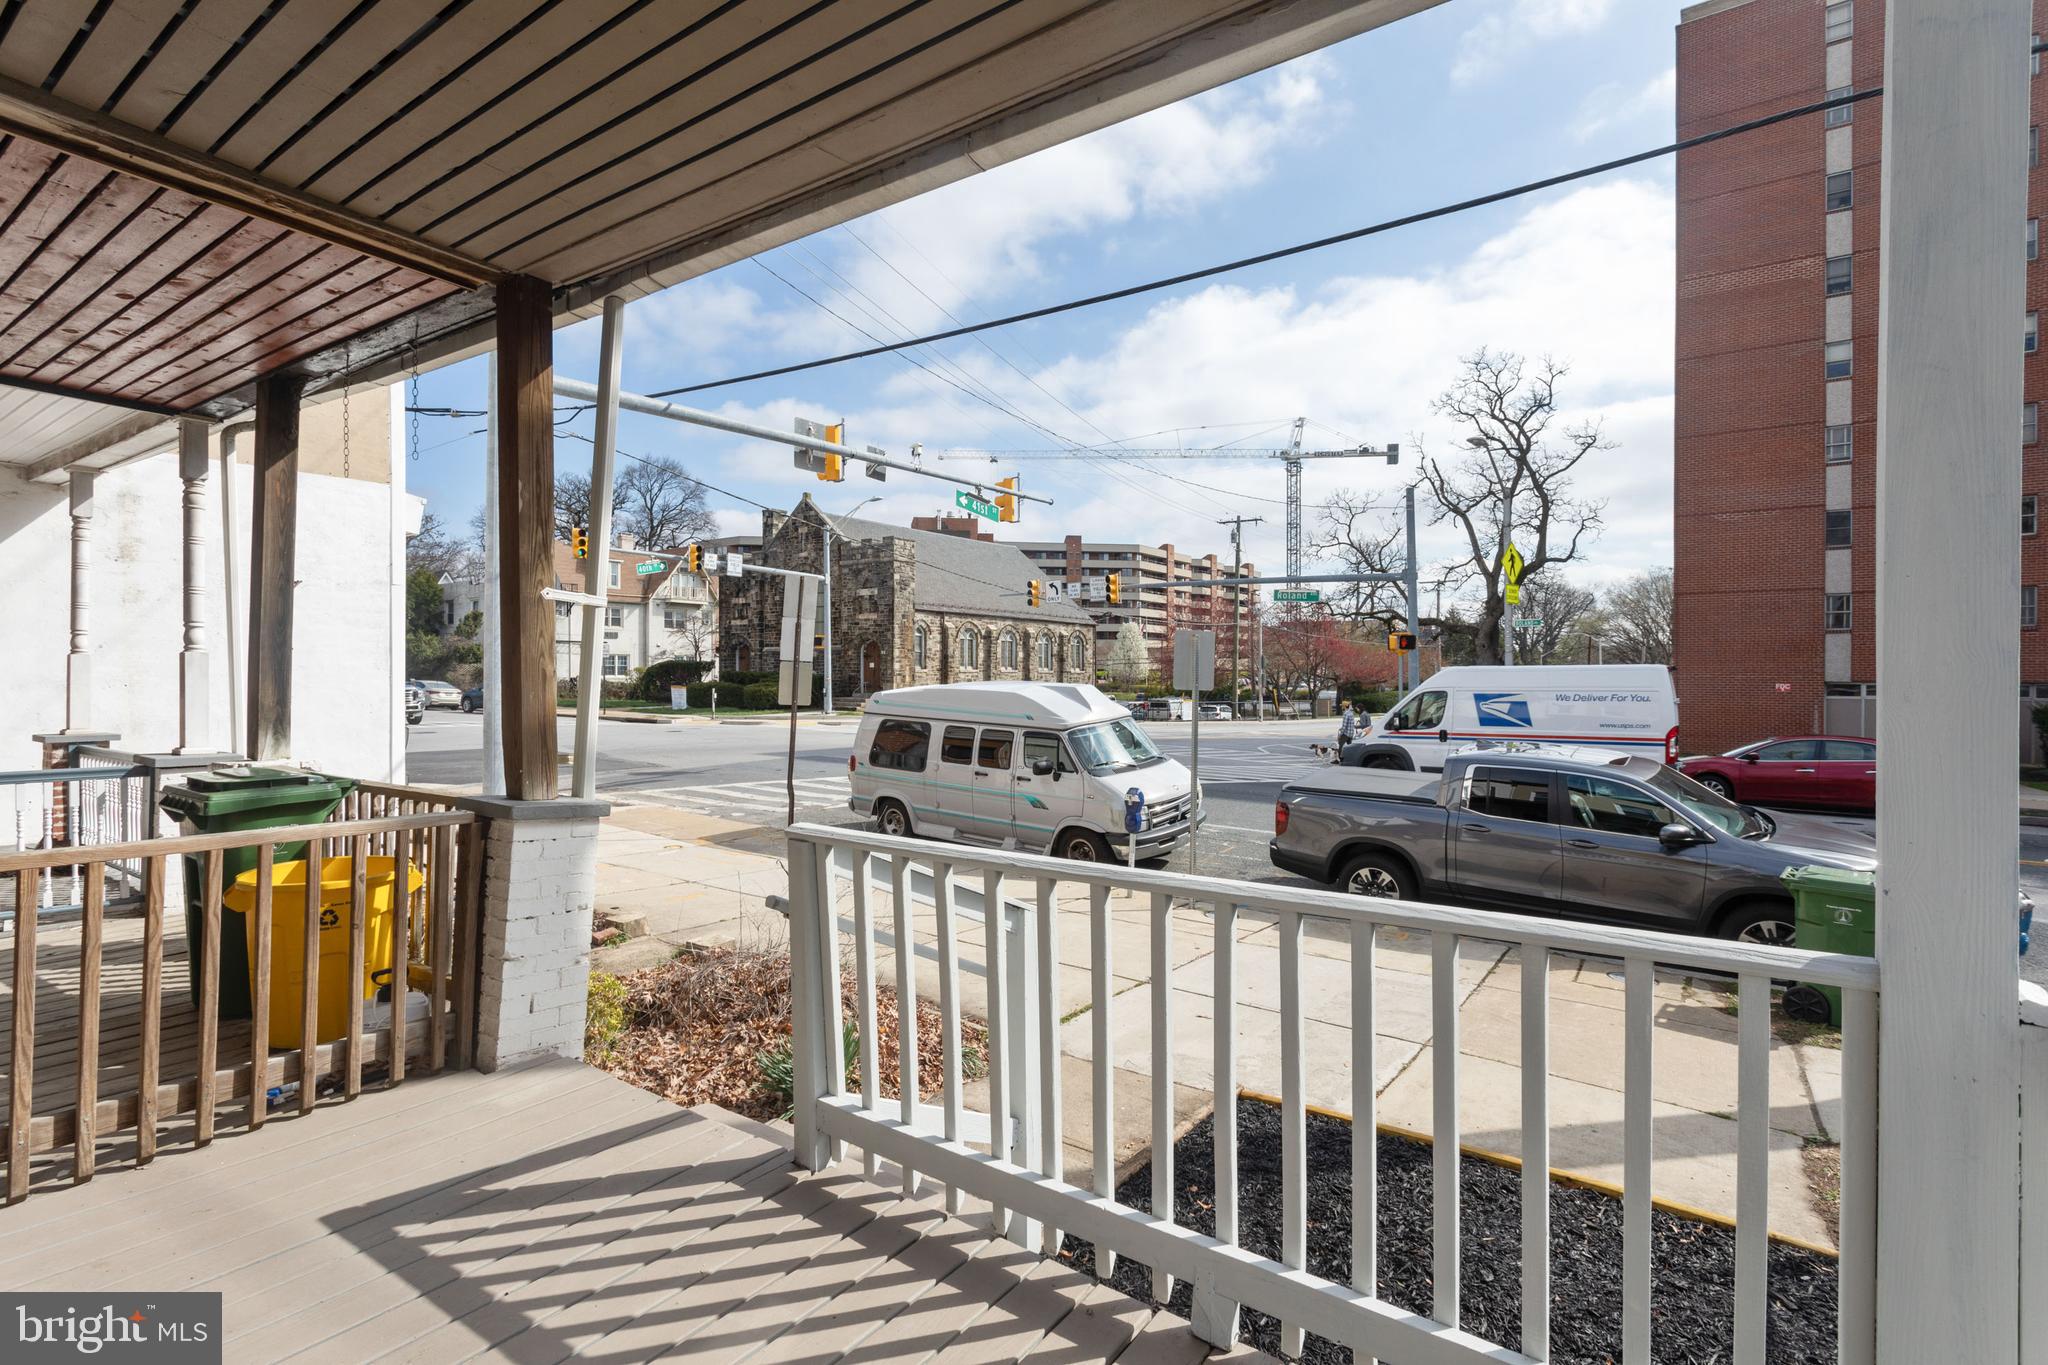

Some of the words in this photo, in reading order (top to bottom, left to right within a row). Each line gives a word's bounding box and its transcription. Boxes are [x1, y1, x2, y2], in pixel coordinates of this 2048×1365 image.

[1277, 592, 1308, 600] Roland
[1555, 693, 1571, 702] We
[1573, 693, 1609, 702] Deliver
[1610, 693, 1629, 702] For
[1630, 694, 1652, 703] You.
[1599, 722, 1651, 730] www.usps.com
